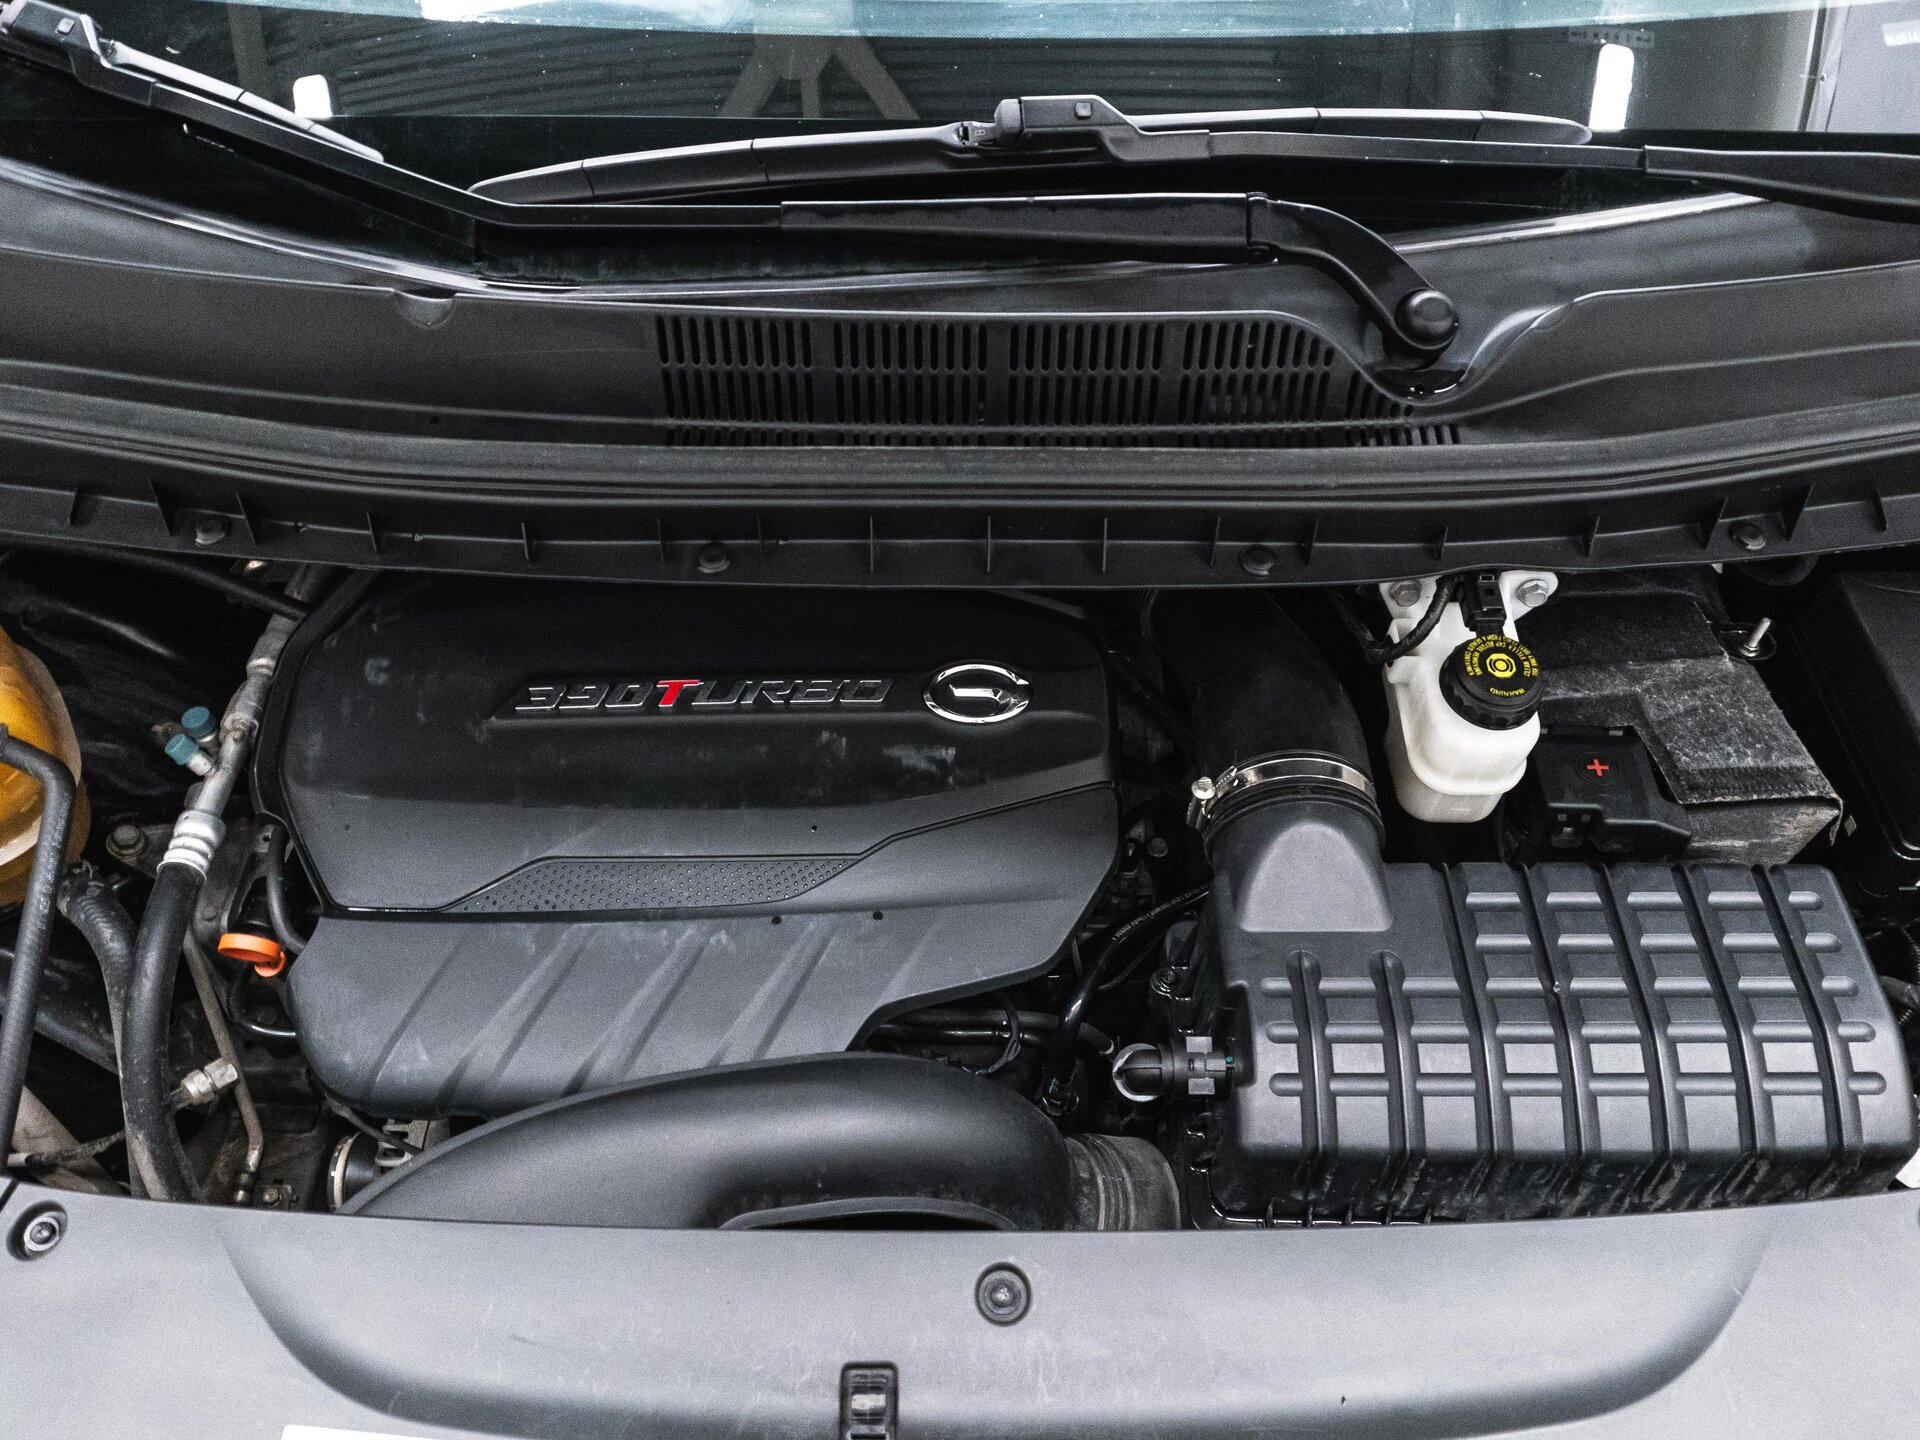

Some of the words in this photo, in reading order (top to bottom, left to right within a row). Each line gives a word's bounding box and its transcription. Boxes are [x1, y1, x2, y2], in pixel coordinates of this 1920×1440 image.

[1467, 638, 1482, 651] SEALED
[1476, 641, 1494, 652] BEFORE
[1508, 645, 1526, 660] FILLER
[1523, 660, 1531, 677] CLEAN
[1490, 687, 1525, 697] WARNING
